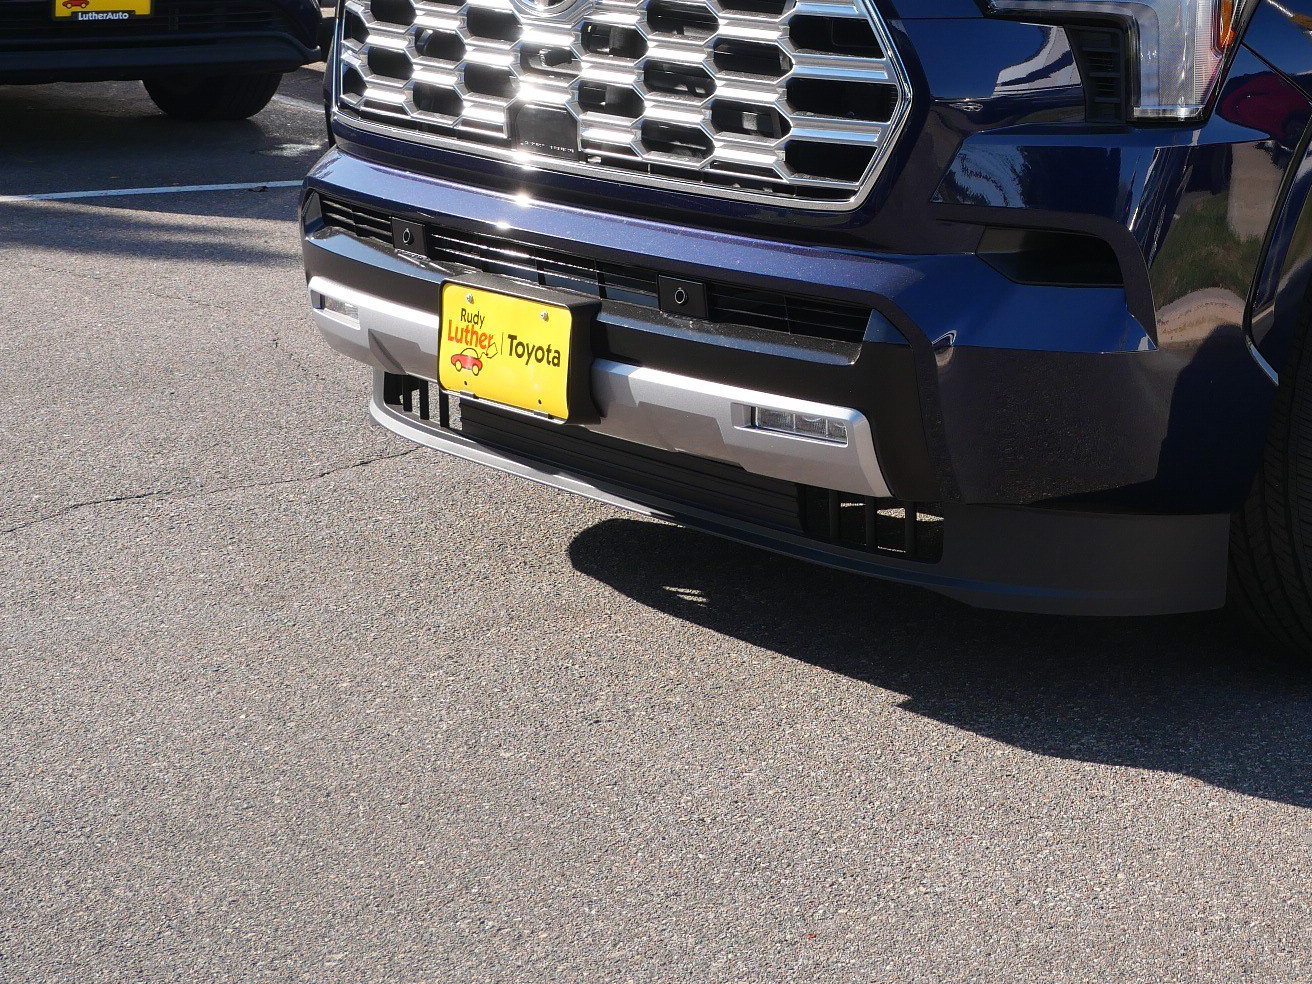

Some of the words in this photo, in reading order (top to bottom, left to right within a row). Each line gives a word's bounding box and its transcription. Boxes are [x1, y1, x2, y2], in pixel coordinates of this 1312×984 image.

[78, 12, 129, 21] LutherAuto
[460, 307, 486, 329] Rudy
[447, 319, 494, 350] Luther
[507, 333, 561, 368] Toyota
